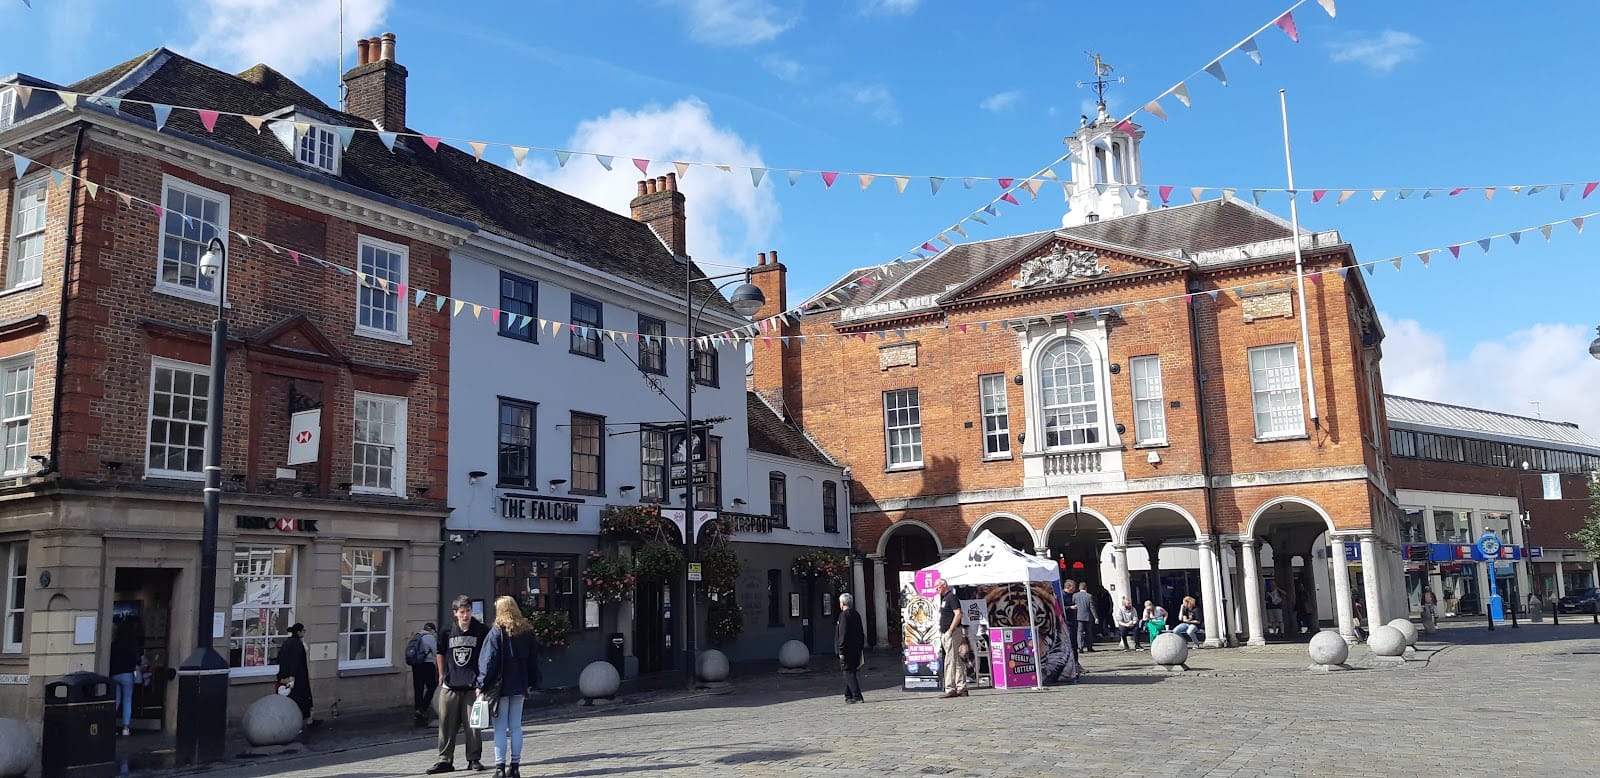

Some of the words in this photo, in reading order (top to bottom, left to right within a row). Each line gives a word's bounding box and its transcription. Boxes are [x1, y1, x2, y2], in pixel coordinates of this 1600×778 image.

[500, 497, 526, 518] THE
[531, 500, 579, 521] FALCON
[235, 514, 277, 530] HSBC
[297, 518, 319, 532] UK
[1010, 653, 1030, 662] WEEKLY
[1014, 665, 1035, 674] LOTTERY
